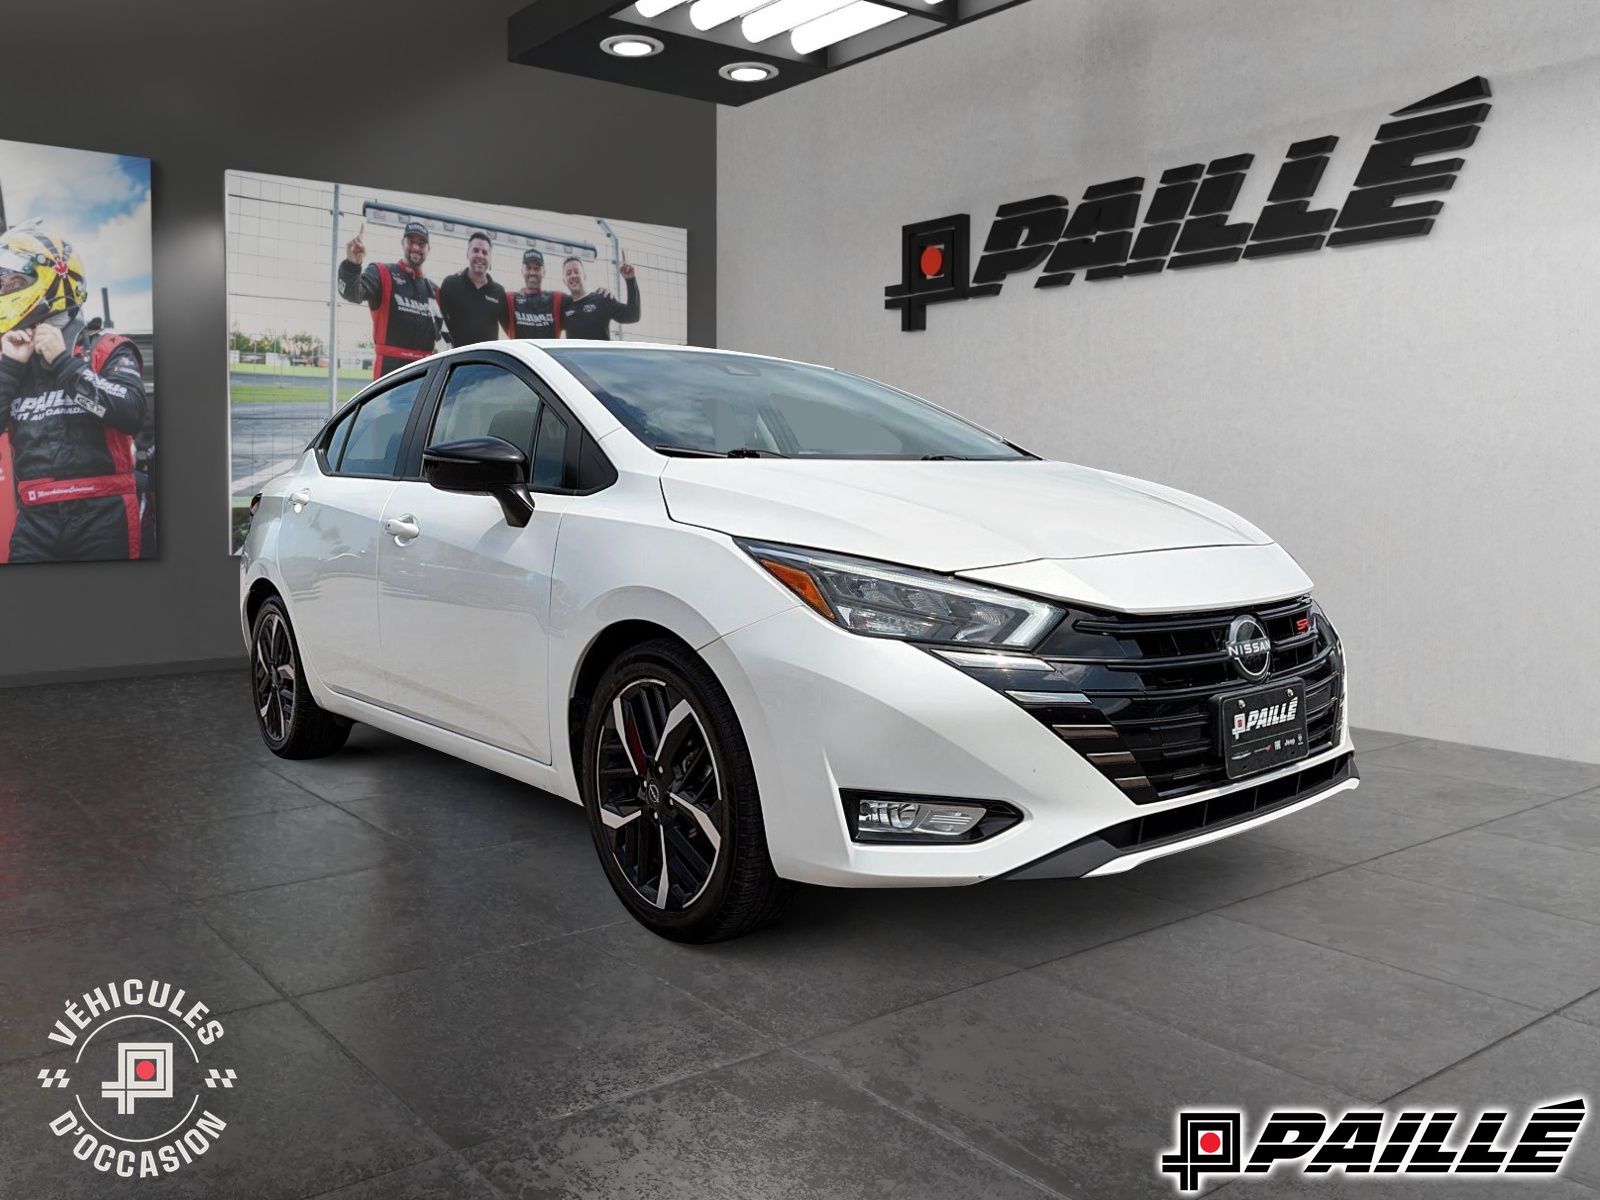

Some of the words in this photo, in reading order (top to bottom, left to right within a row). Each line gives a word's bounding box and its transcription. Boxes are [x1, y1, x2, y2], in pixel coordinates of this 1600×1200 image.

[972, 75, 1493, 299] PAILLÉ
[1228, 639, 1271, 657] NISSAN
[1246, 697, 1299, 733] PAILLÉ
